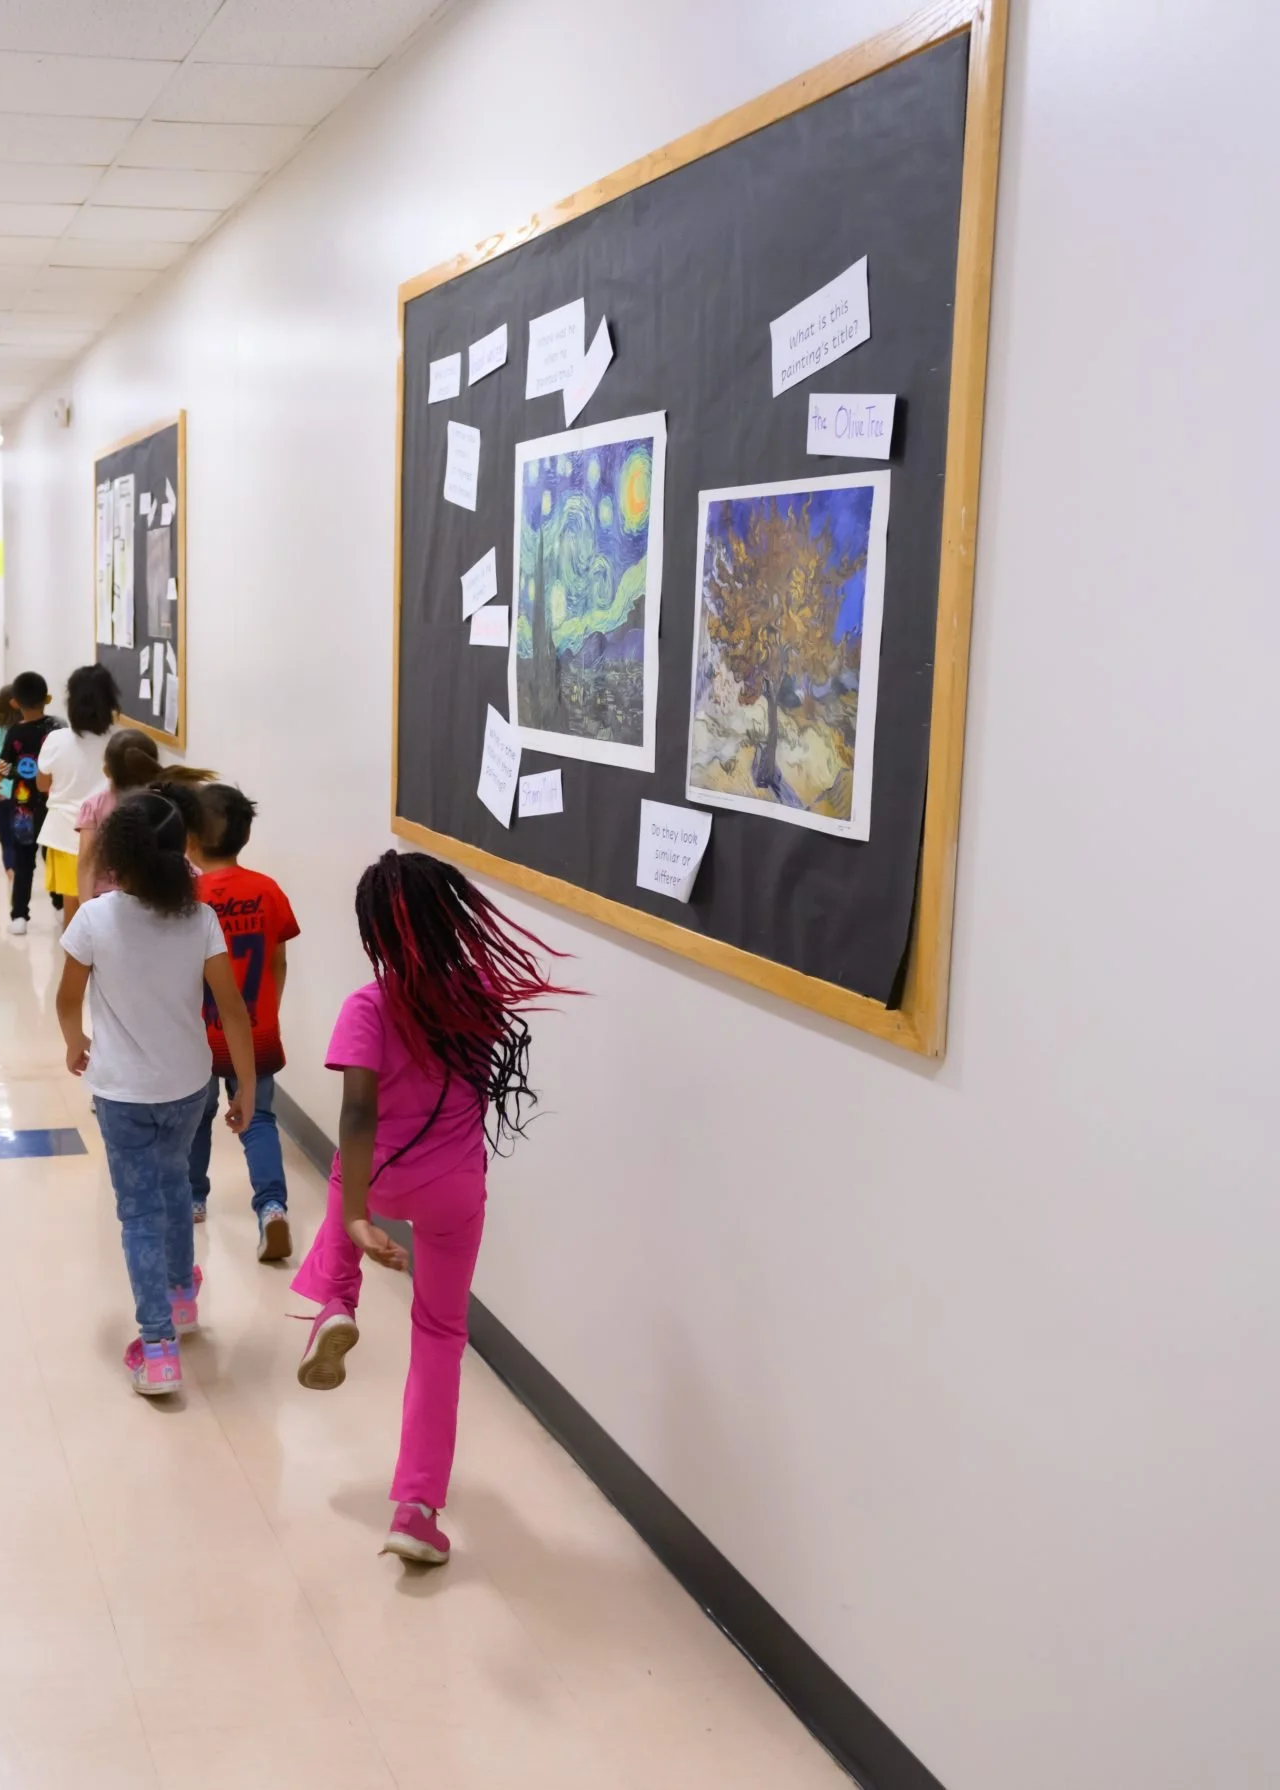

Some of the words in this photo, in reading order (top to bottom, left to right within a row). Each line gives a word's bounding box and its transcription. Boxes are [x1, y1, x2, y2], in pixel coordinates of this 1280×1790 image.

[789, 323, 815, 350] What
[819, 313, 827, 330] is
[830, 299, 849, 323] this
[780, 341, 829, 385] painting's
[832, 319, 859, 351] title?
[834, 404, 864, 440] Olive
[865, 405, 884, 439] Tree
[651, 823, 660, 837] Do
[662, 824, 678, 844] they
[681, 827, 698, 845] look
[655, 848, 680, 864] similar
[682, 856, 691, 866] or
